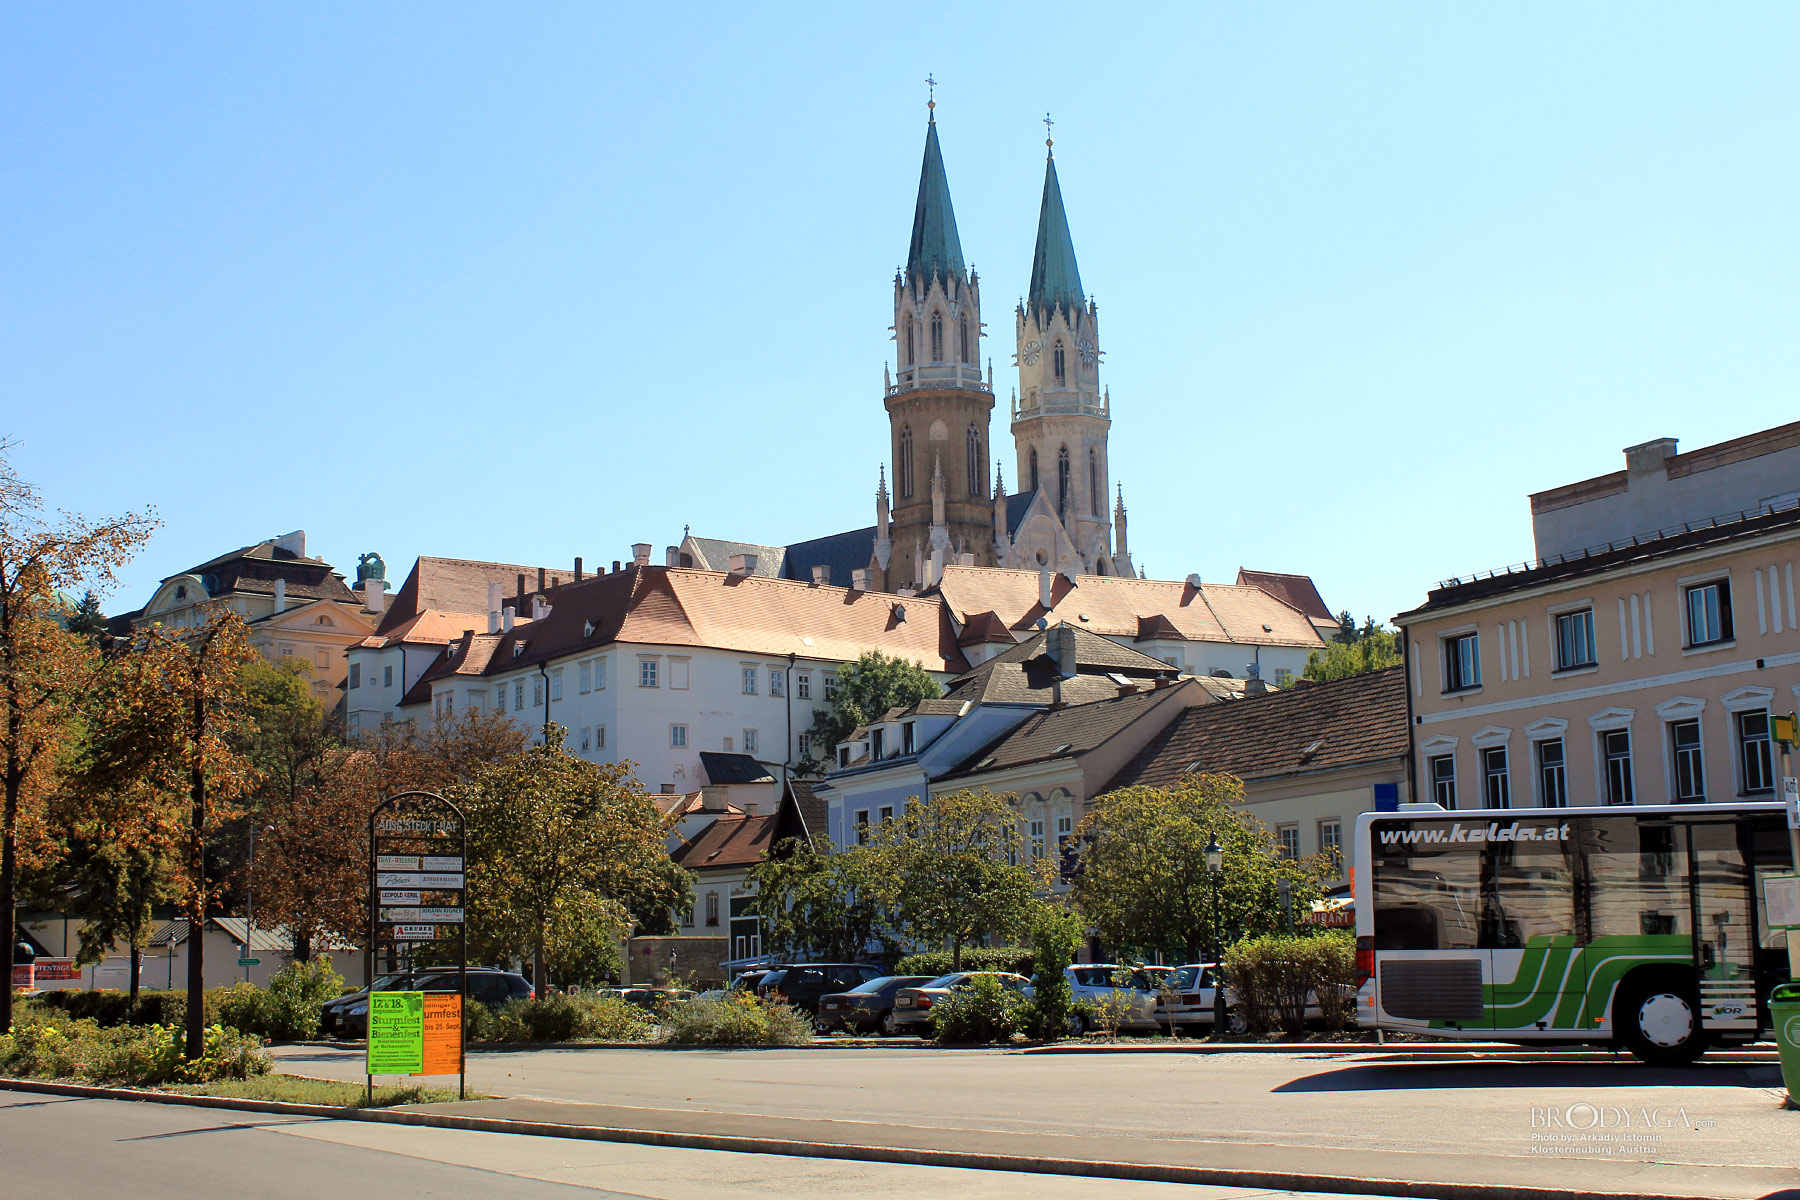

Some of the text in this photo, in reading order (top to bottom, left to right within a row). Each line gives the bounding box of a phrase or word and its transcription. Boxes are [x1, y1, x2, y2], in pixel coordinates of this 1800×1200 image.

[373, 999, 383, 1008] 17.
[391, 998, 404, 1008] 18.
[424, 1009, 461, 1019] urmfest
[1713, 1006, 1742, 1014] VOR
[372, 1016, 420, 1024] Sturmfest
[372, 1030, 420, 1038] Bienenfest
